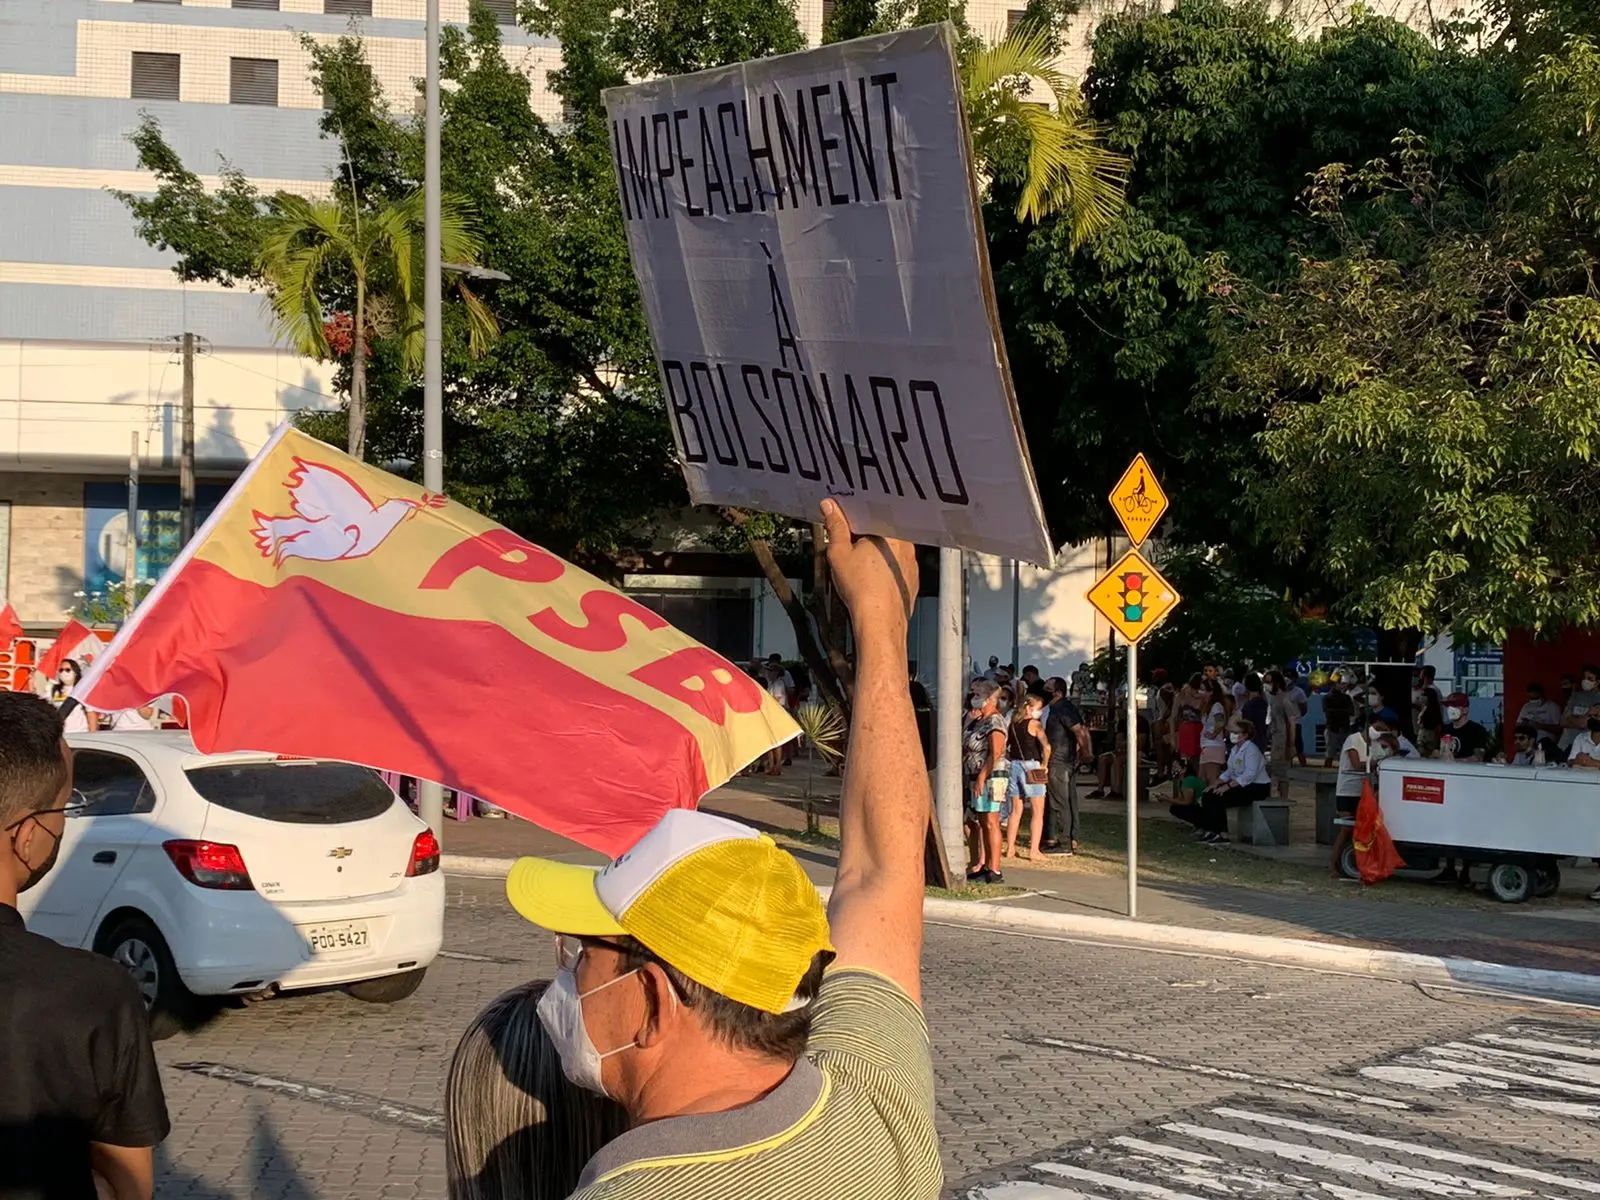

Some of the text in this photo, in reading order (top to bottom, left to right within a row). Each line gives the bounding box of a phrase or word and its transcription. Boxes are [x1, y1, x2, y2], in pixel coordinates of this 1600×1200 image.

[612, 72, 902, 221] IMPEACHMENT
[662, 359, 969, 506] BOLSONARO
[416, 528, 764, 726] PSB
